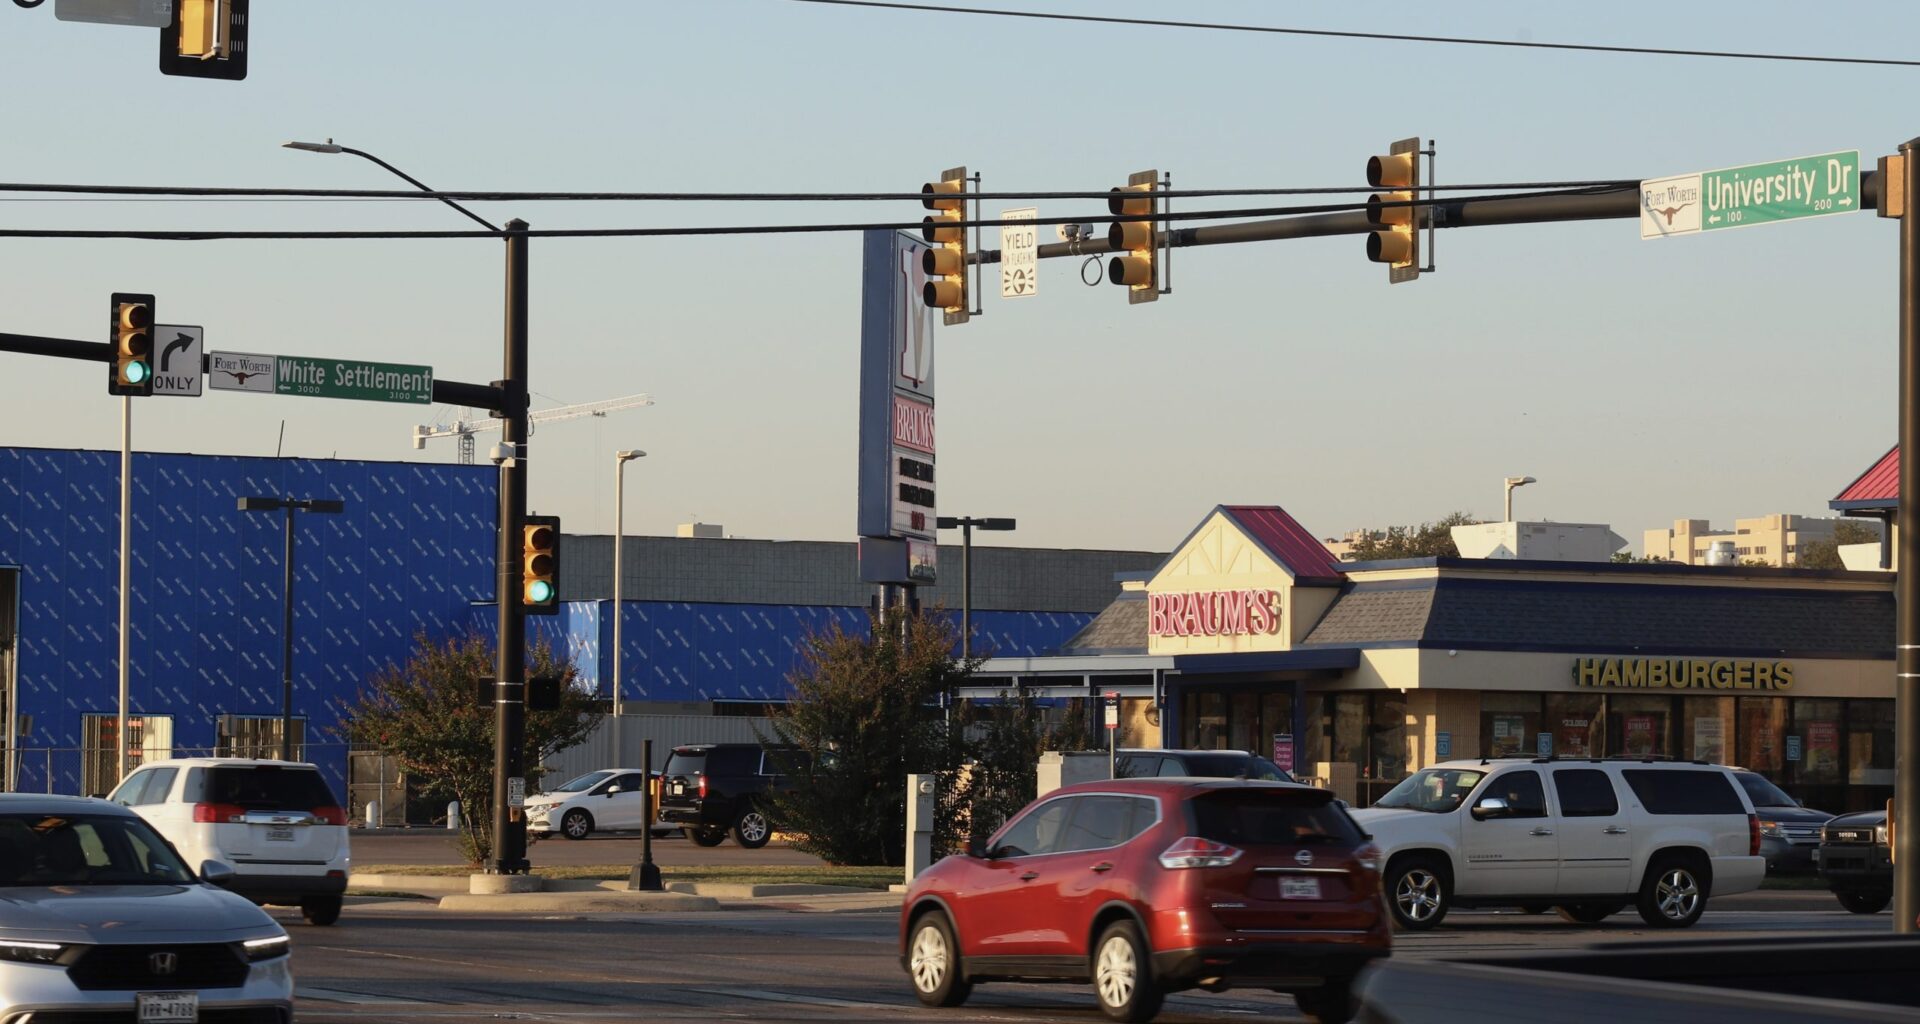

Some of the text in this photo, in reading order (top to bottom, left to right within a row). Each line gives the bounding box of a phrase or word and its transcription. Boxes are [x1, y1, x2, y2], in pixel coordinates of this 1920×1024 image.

[1708, 158, 1852, 211] University Dr
[1814, 198, 1832, 211] 200
[1726, 212, 1742, 223] 100
[1005, 232, 1033, 249] YIELD
[155, 375, 194, 390] ONLY
[278, 357, 431, 392] White Settlement
[297, 385, 320, 394] 3000
[389, 391, 411, 400] 3100
[895, 402, 935, 449] BRAUM'S
[1148, 589, 1273, 636] BRAUM'S
[1578, 658, 1794, 690] HAMBURGERS
